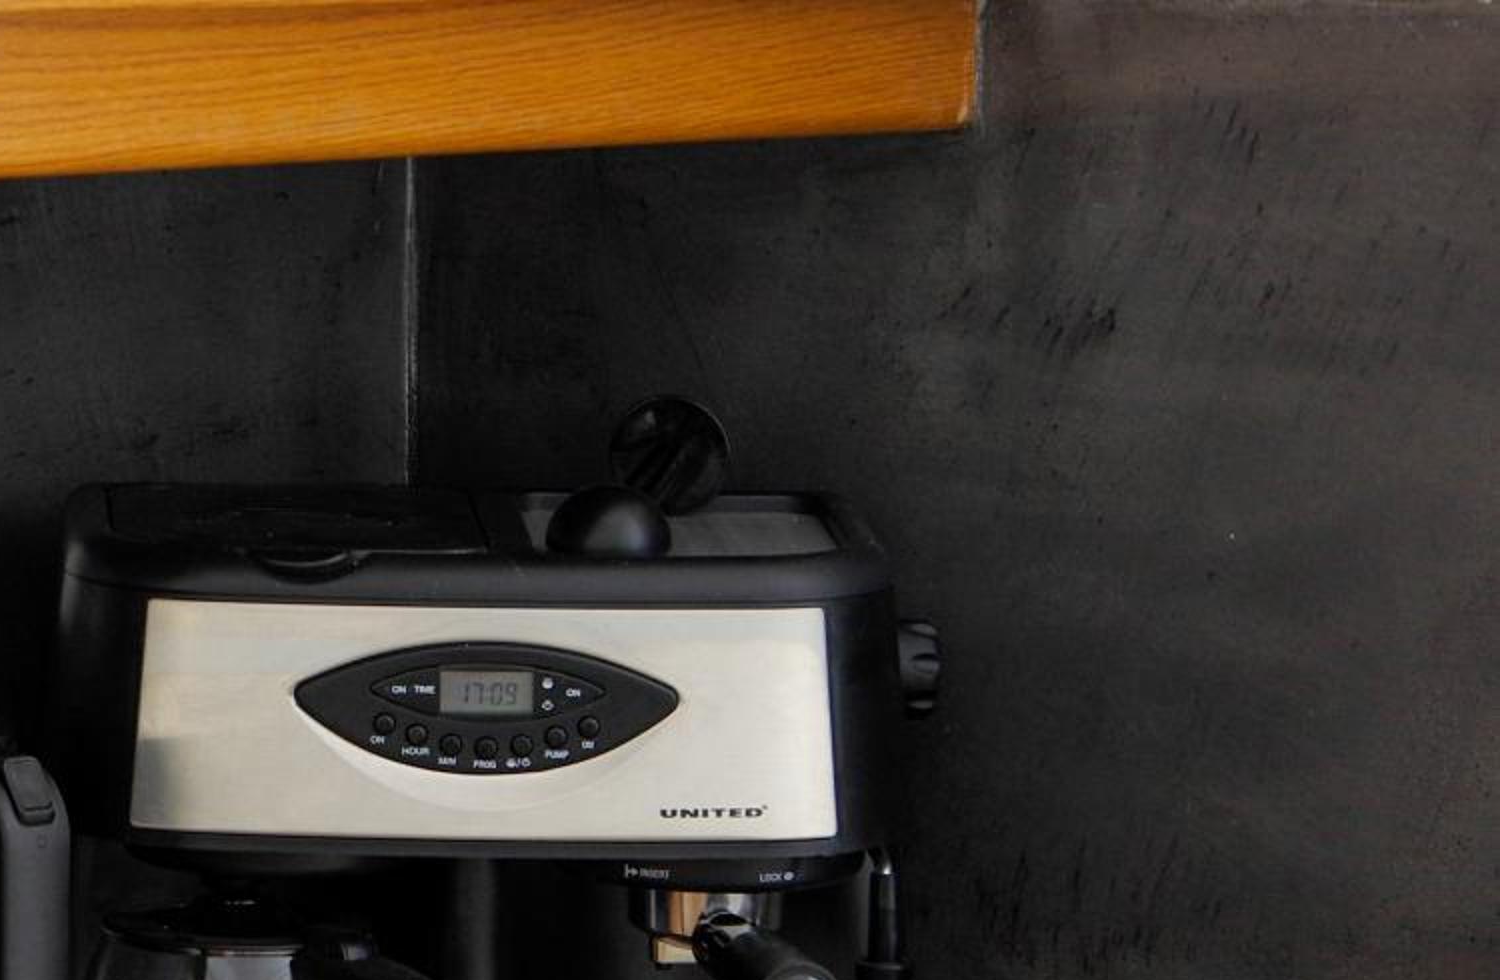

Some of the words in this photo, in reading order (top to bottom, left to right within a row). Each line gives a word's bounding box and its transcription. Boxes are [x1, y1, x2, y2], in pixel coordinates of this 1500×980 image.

[391, 685, 407, 694] ON
[414, 685, 436, 694] TIME
[565, 688, 581, 697] ON
[369, 735, 385, 744] ON
[401, 746, 430, 756] HOUR
[545, 748, 570, 759] PUMP
[473, 759, 497, 769] PROG
[659, 807, 764, 819] UNITED
[759, 871, 782, 882] LOCK
